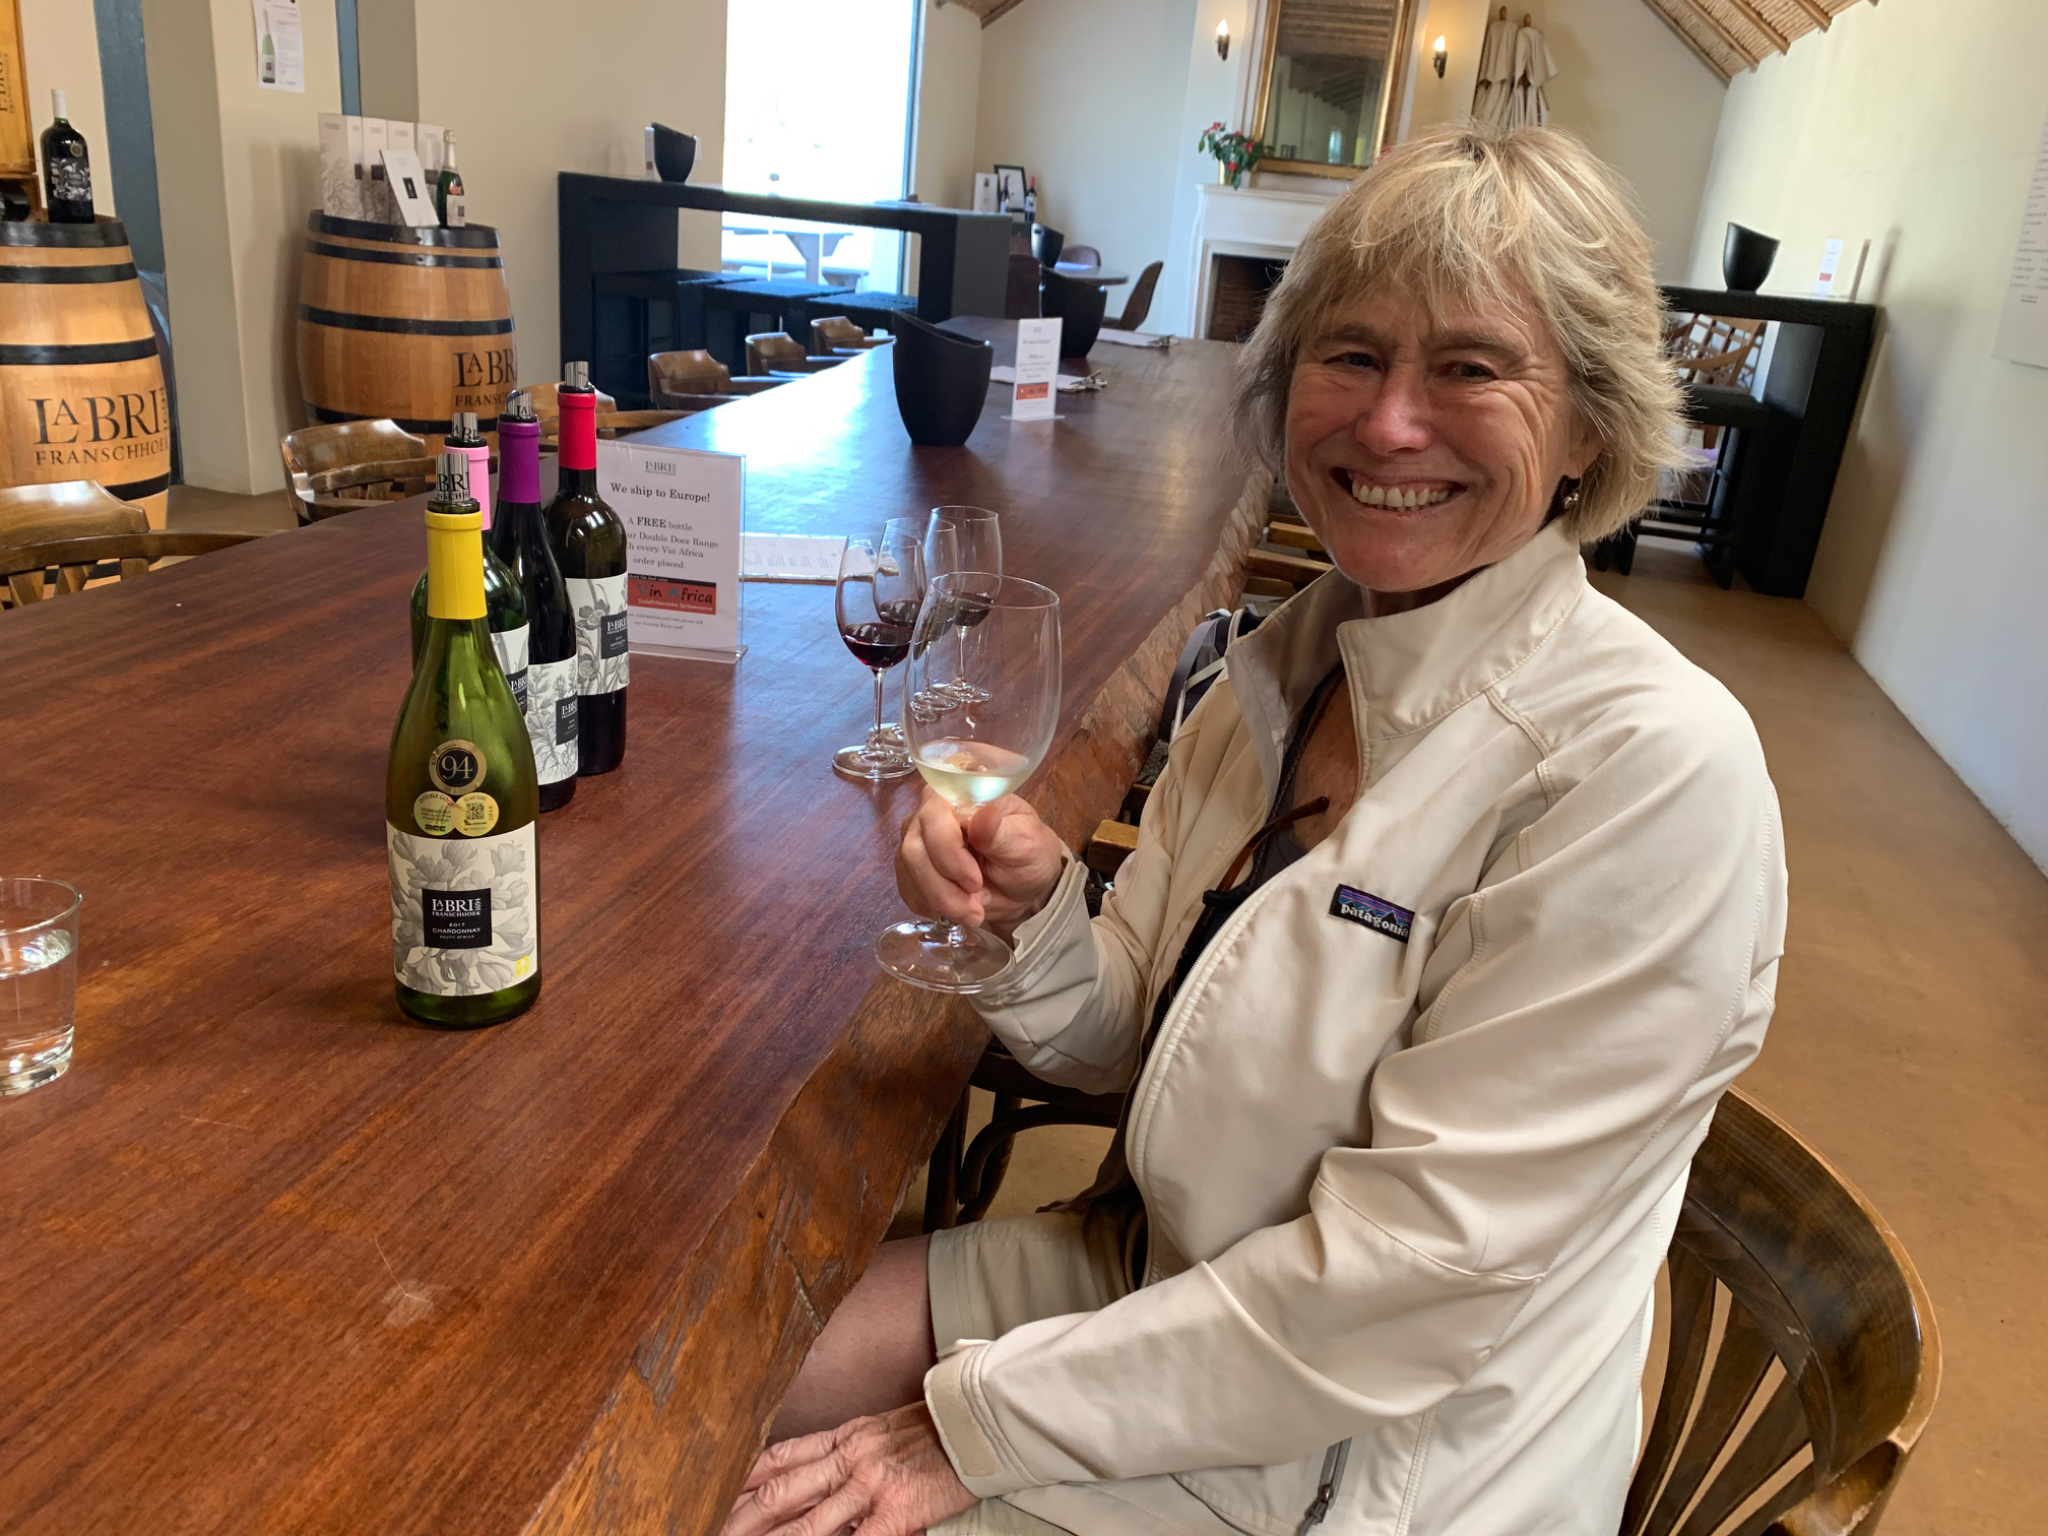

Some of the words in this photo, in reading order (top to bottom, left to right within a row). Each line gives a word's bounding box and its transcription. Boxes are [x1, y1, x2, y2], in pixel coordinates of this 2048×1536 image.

[452, 348, 516, 387] LABR
[610, 482, 628, 493] We
[630, 485, 653, 498] ship
[655, 488, 666, 498] to
[669, 489, 710, 503] Europe!
[627, 517, 634, 525] A
[636, 516, 667, 528] FREE
[668, 521, 693, 531] bottle
[639, 531, 668, 542] Double
[670, 535, 691, 544] Door
[692, 537, 719, 549] Range
[636, 544, 660, 554] every
[661, 545, 677, 555] Vin
[678, 548, 704, 558] Africa
[632, 557, 655, 566] order
[657, 559, 686, 569] placed.
[637, 582, 662, 597] Vin
[667, 586, 713, 604] Africa
[441, 755, 473, 780] 94
[1340, 903, 1410, 937] patagonia
[431, 927, 482, 935] CHARDONNAY
